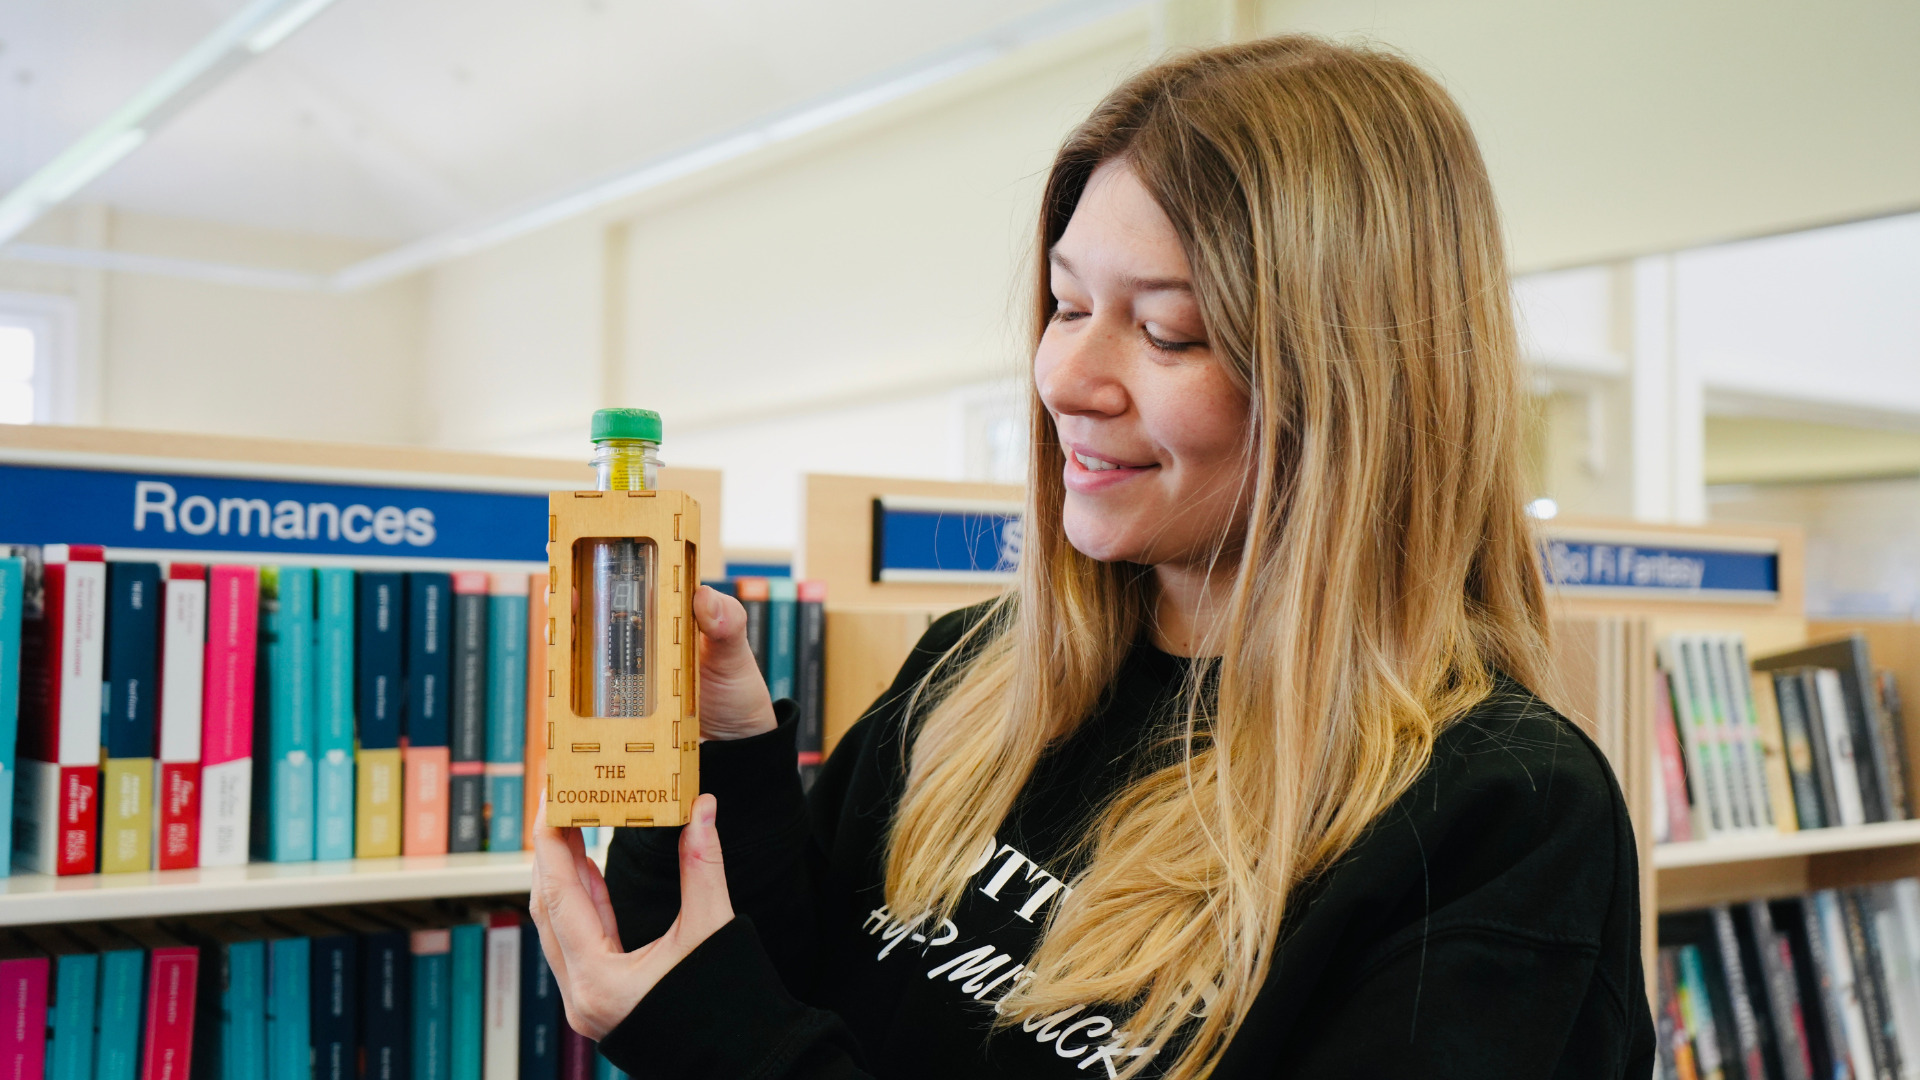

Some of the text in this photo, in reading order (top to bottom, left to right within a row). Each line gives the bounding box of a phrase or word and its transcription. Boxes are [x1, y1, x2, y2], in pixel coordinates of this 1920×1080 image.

[133, 480, 437, 547] Romances
[1618, 545, 1706, 595] Fantasy
[594, 765, 626, 779] THE
[557, 789, 668, 804] COORDINATOR
